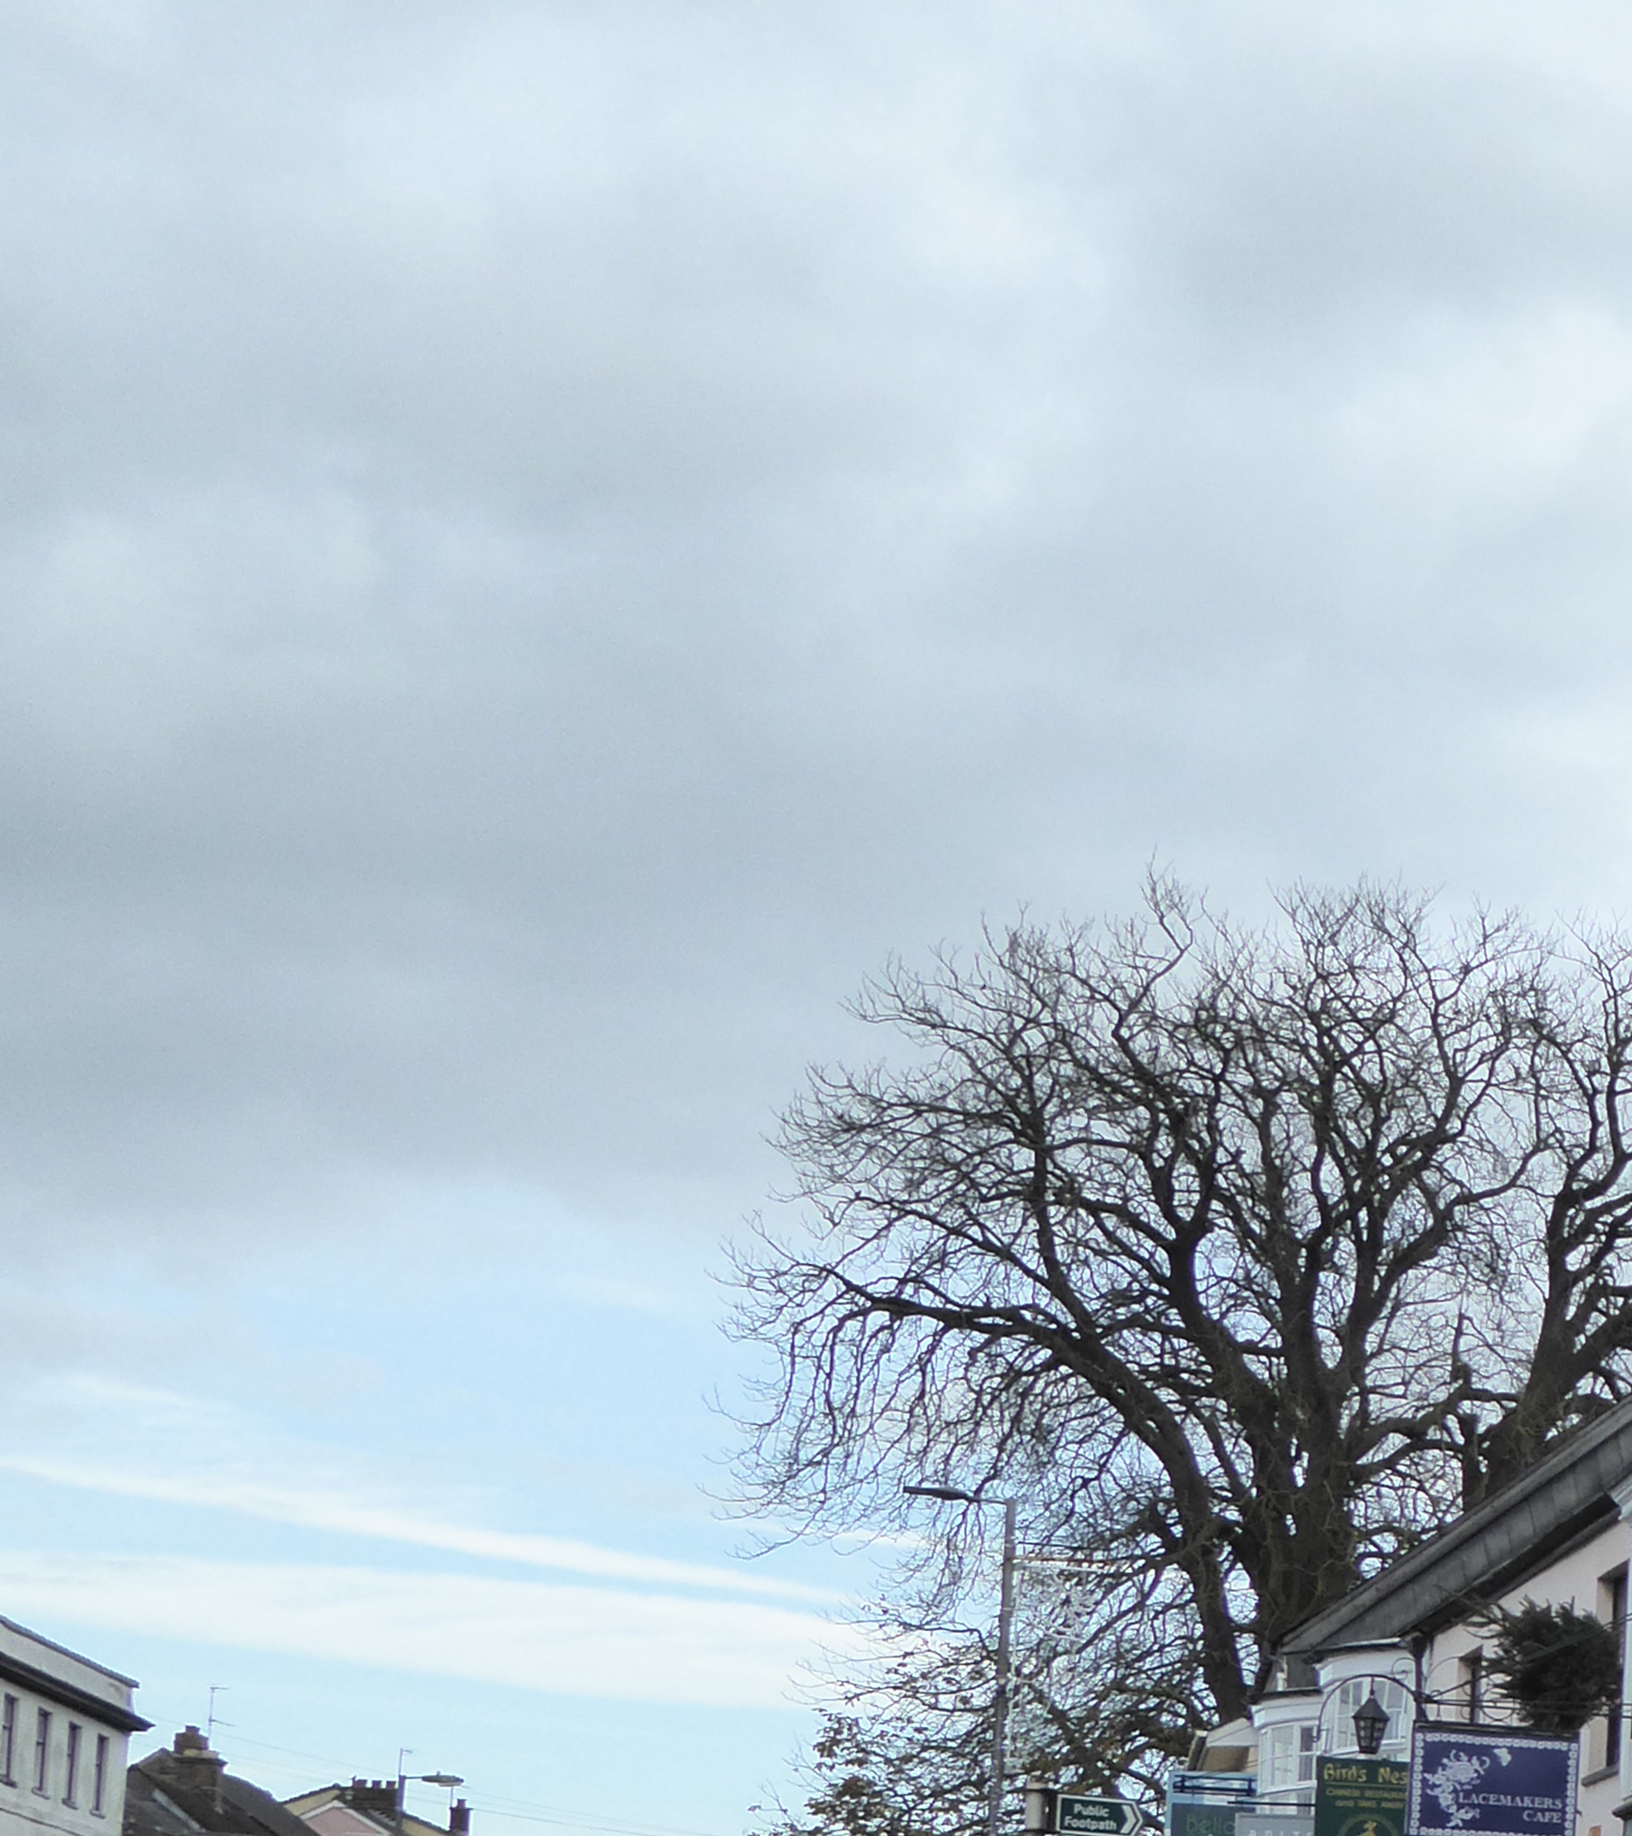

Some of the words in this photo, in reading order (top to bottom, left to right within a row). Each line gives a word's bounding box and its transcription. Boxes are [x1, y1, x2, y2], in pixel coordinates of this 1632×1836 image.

[1378, 1766, 1408, 1784] Nes
[1459, 1792, 1563, 1810] LACEMAKERS
[1073, 1803, 1110, 1817] Public
[1522, 1810, 1562, 1823] CAFE
[1064, 1816, 1118, 1831] Footpath
